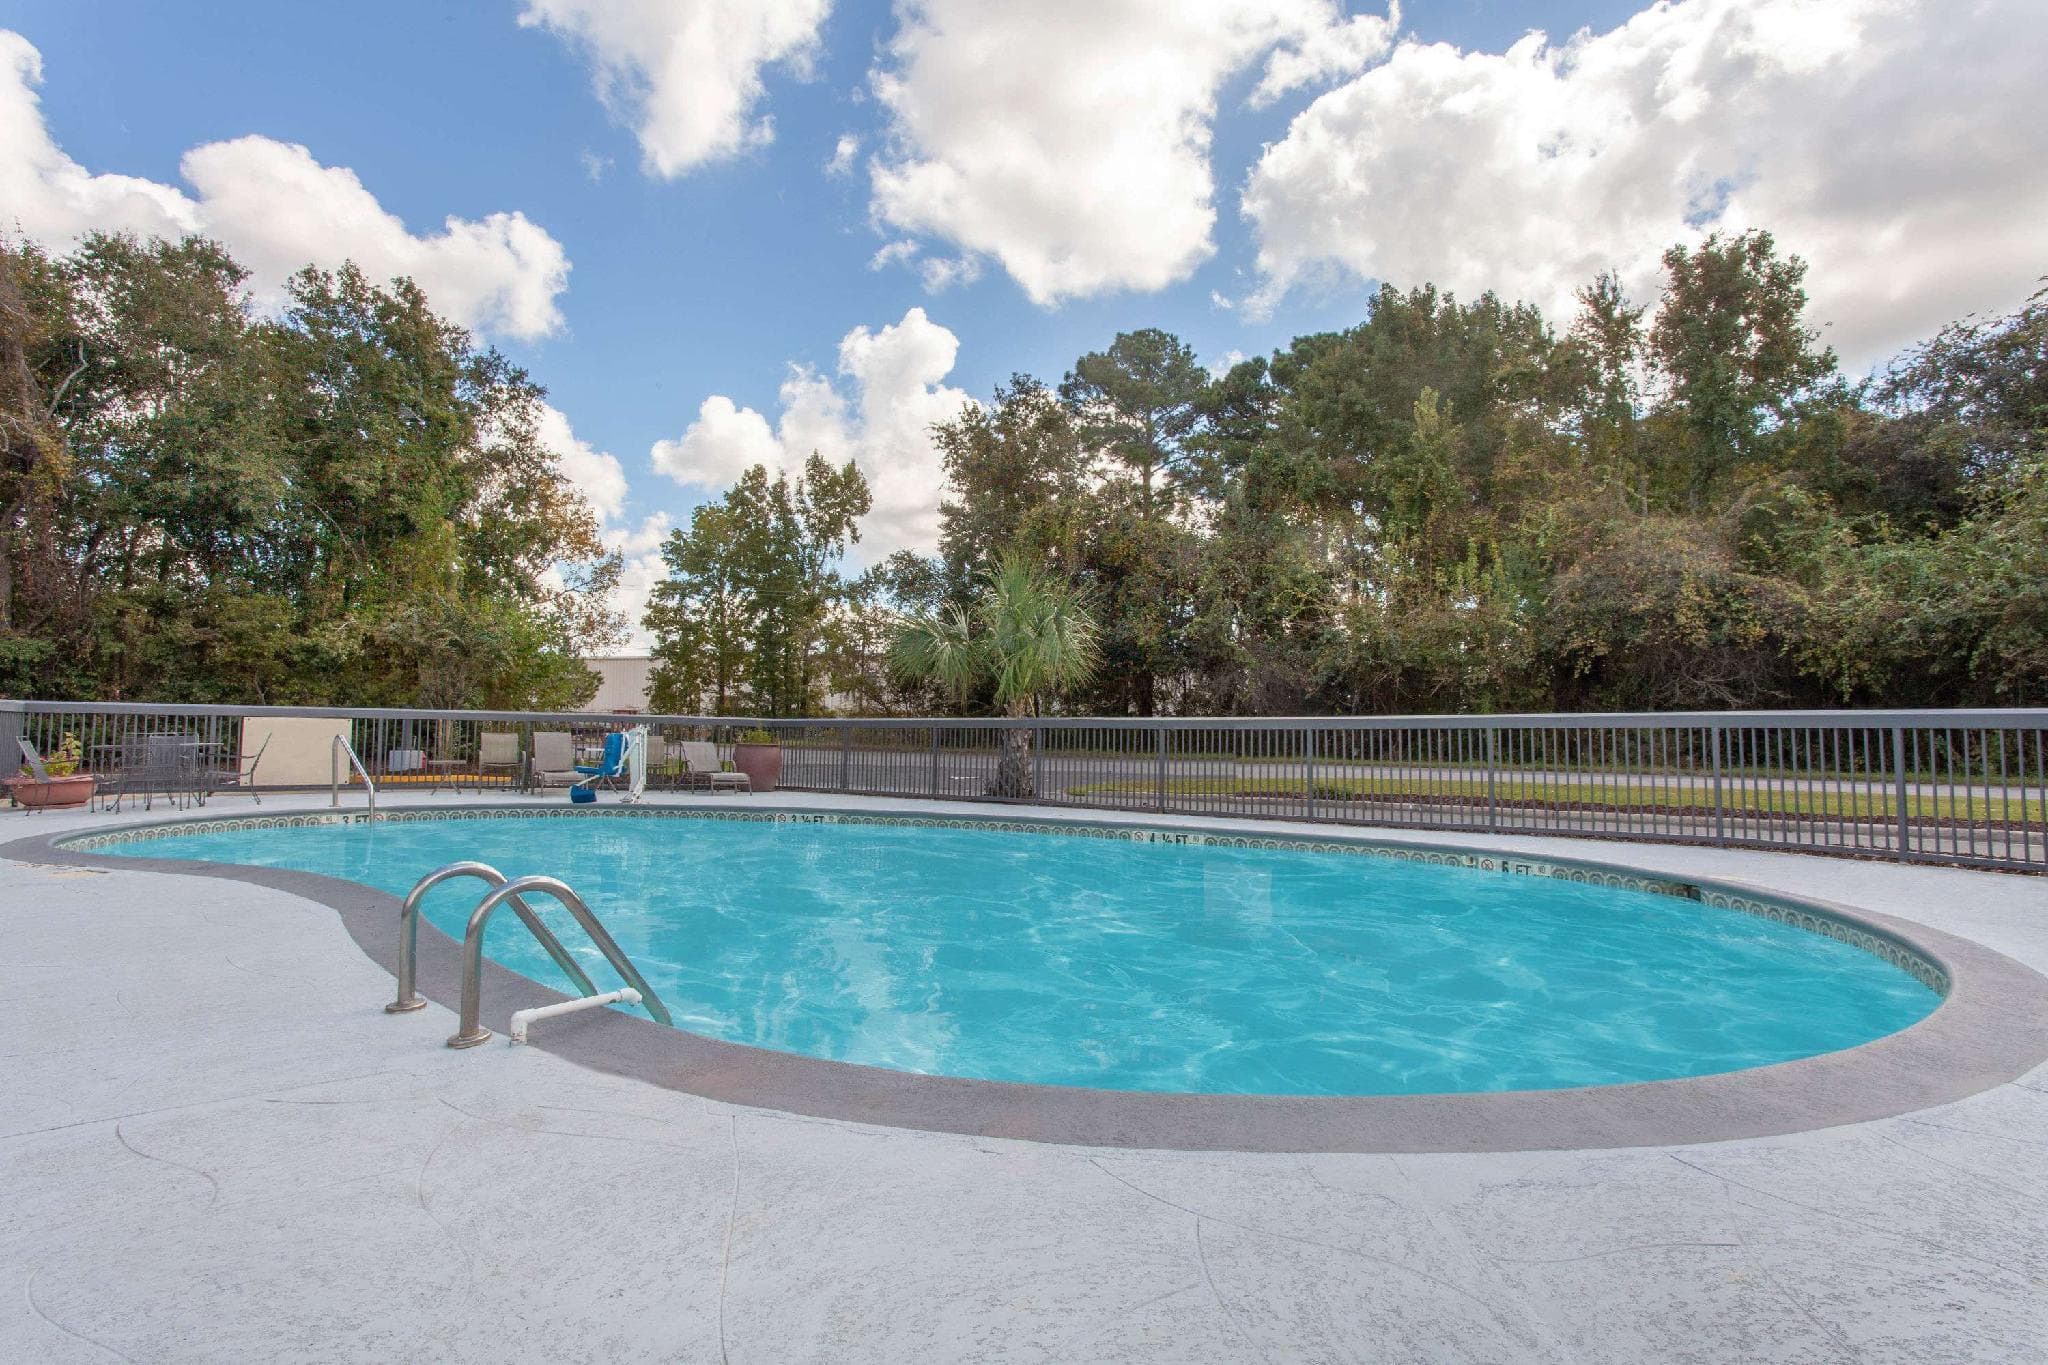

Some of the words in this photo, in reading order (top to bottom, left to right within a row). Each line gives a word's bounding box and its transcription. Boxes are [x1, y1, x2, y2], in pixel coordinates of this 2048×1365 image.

[813, 815, 825, 825] FT
[1175, 834, 1188, 845] FT
[1515, 864, 1531, 876] FT
